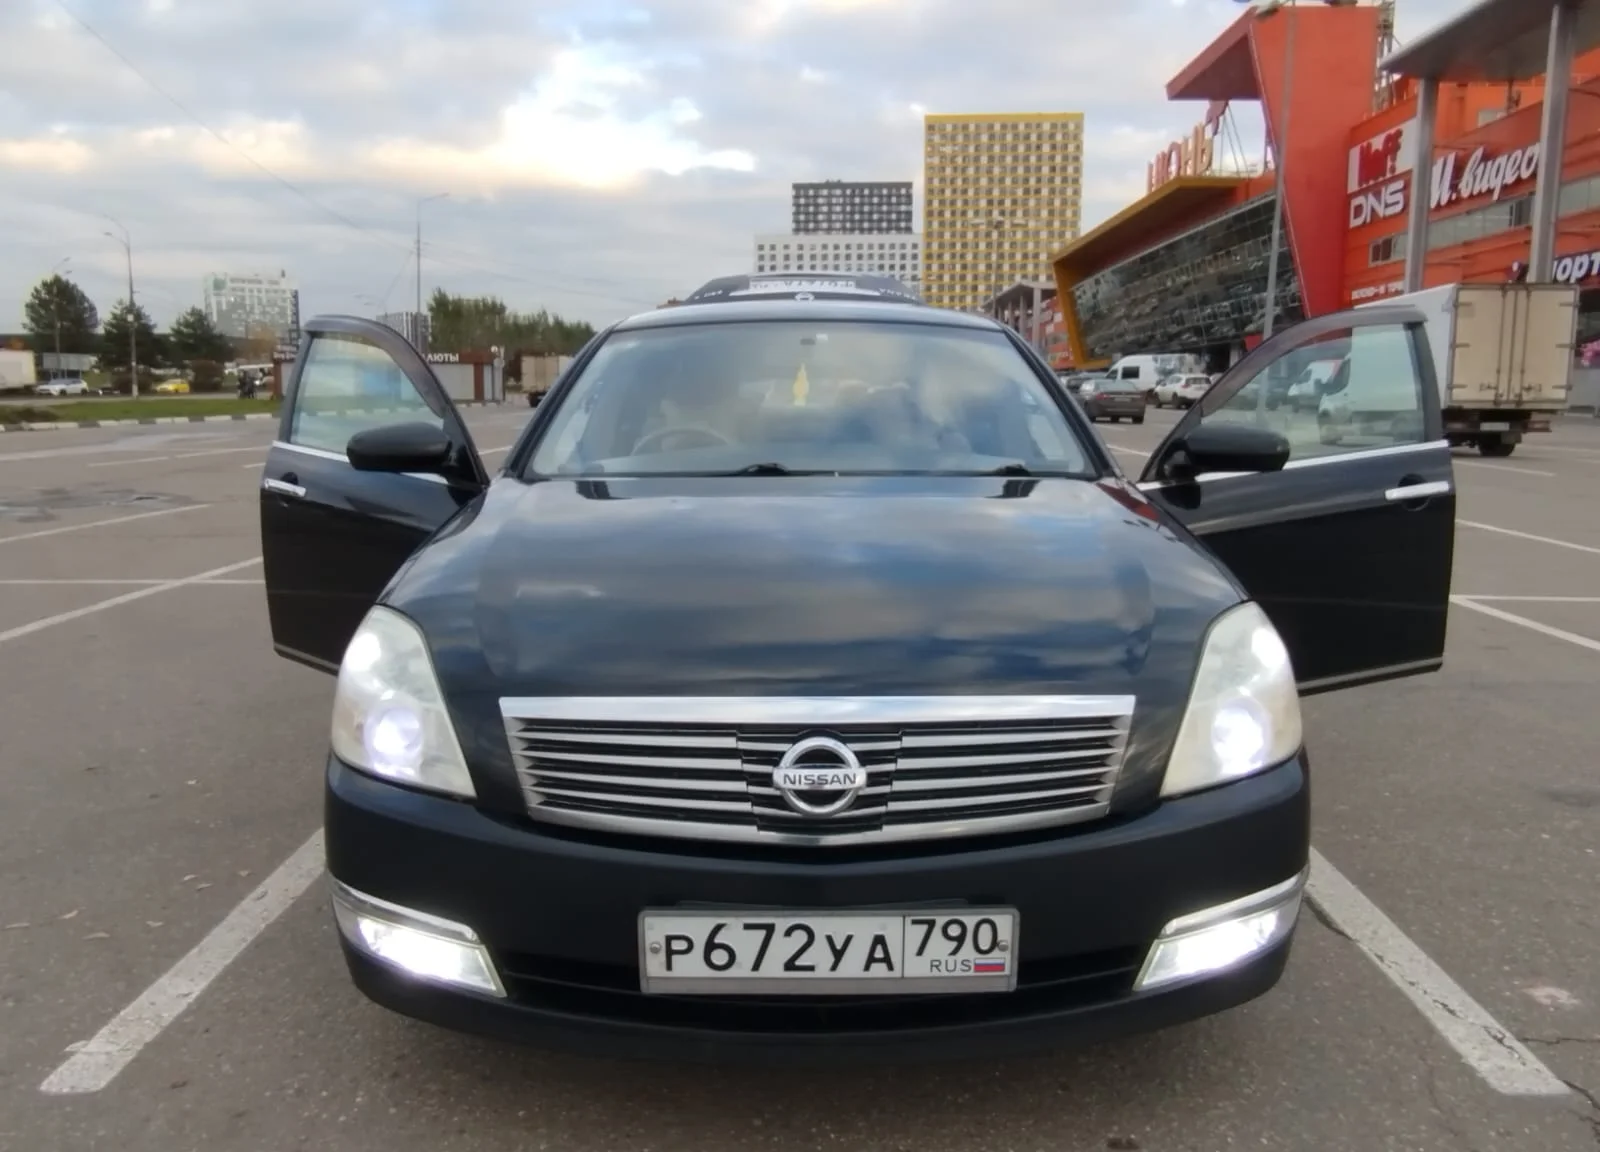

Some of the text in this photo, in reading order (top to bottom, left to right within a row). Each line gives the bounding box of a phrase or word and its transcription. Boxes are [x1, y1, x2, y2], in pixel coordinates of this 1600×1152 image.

[1349, 180, 1405, 229] DNS
[423, 352, 460, 363] ЛЮТЫ
[783, 773, 857, 786] NISSAN
[910, 917, 998, 957] 790
[930, 959, 972, 973] RUS
